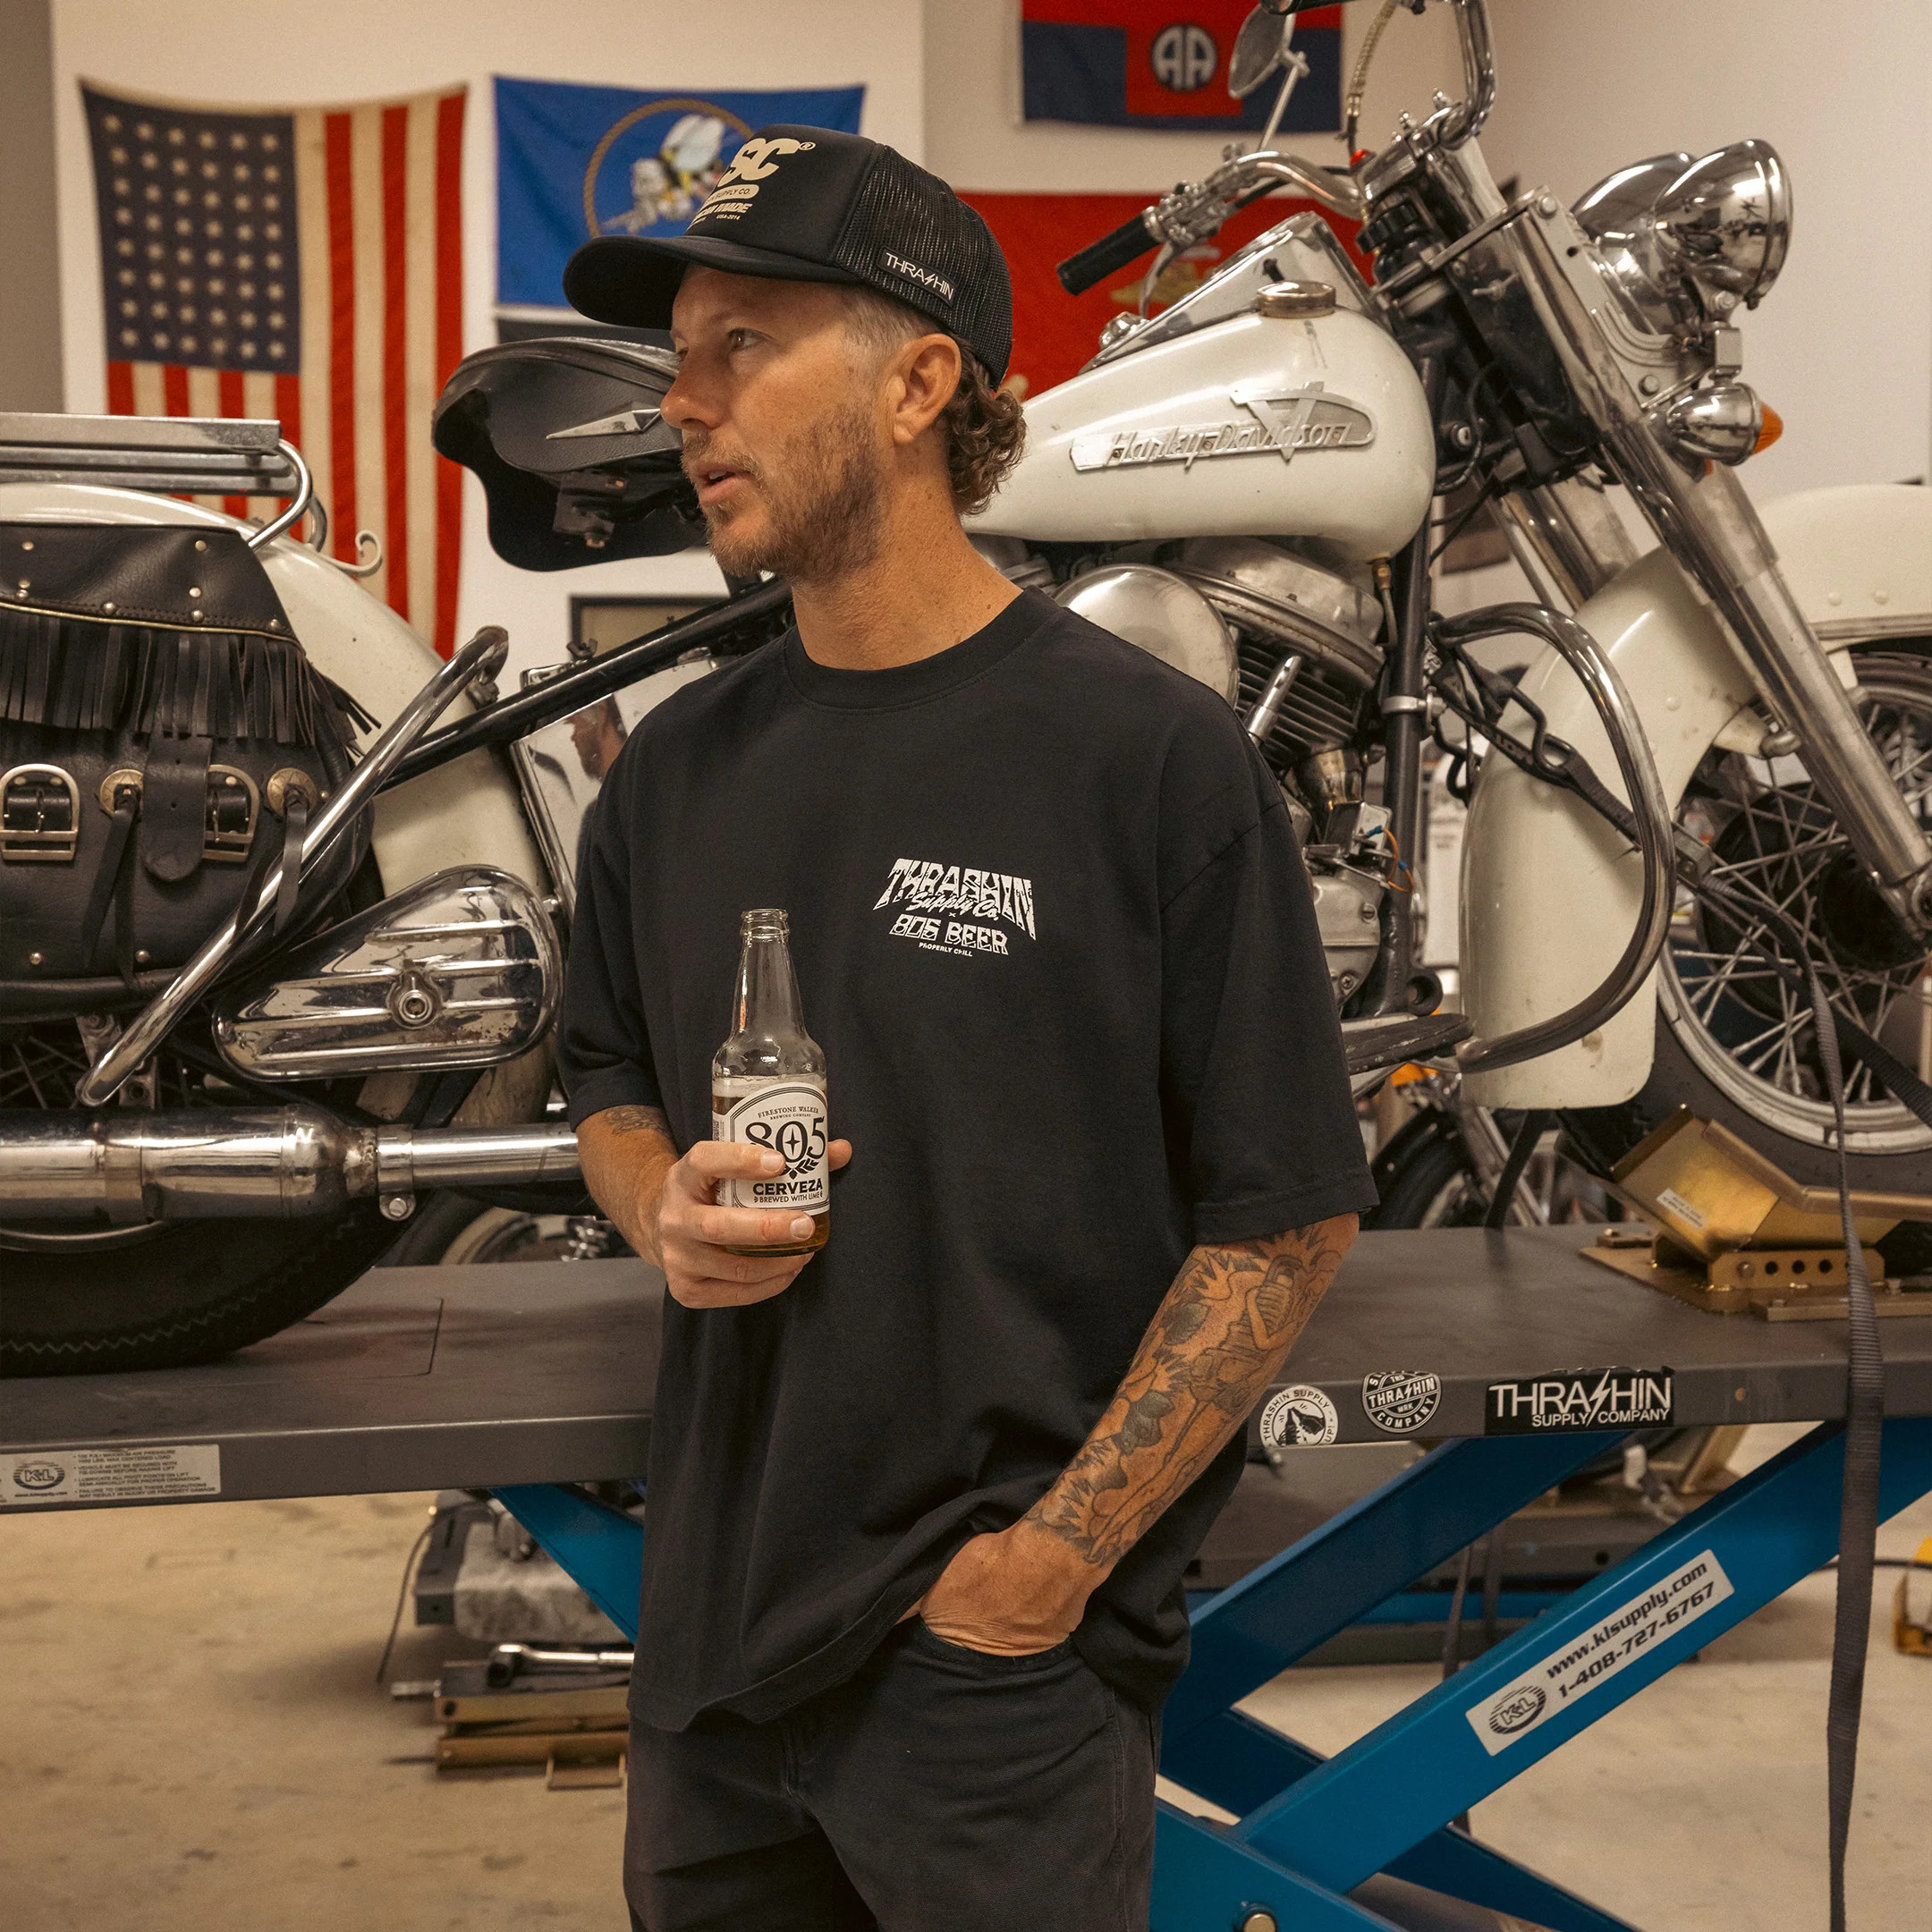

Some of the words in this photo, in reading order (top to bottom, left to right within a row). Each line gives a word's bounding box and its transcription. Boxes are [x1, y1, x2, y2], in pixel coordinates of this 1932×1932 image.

[1152, 25, 1217, 89] AA
[714, 202, 753, 213] MADE
[873, 858, 1037, 940] THRASHIN
[906, 892, 973, 915] Supply
[919, 942, 953, 953] PROPERLY
[953, 949, 973, 957] CHILL
[945, 921, 1009, 955] BEER
[758, 1106, 797, 1118] FIRESTONE
[799, 1106, 819, 1114] WALKER
[745, 1116, 826, 1163] 805
[752, 1178, 823, 1196] CERVEZA
[809, 1191, 820, 1199] LIME
[1368, 1377, 1436, 1408] THRASHIN
[1488, 1369, 1672, 1420] THRASHIN
[1263, 1392, 1290, 1441] THRASHIN
[1293, 1389, 1330, 1409] SUPPLY
[1377, 1397, 1435, 1428] COMPANY
[1532, 1412, 1589, 1428] SUPPLY
[1597, 1409, 1669, 1424] COMPANY
[1546, 1563, 1707, 1679] www.klsupply.com
[1559, 1581, 1715, 1699] 1-408-727-6767
